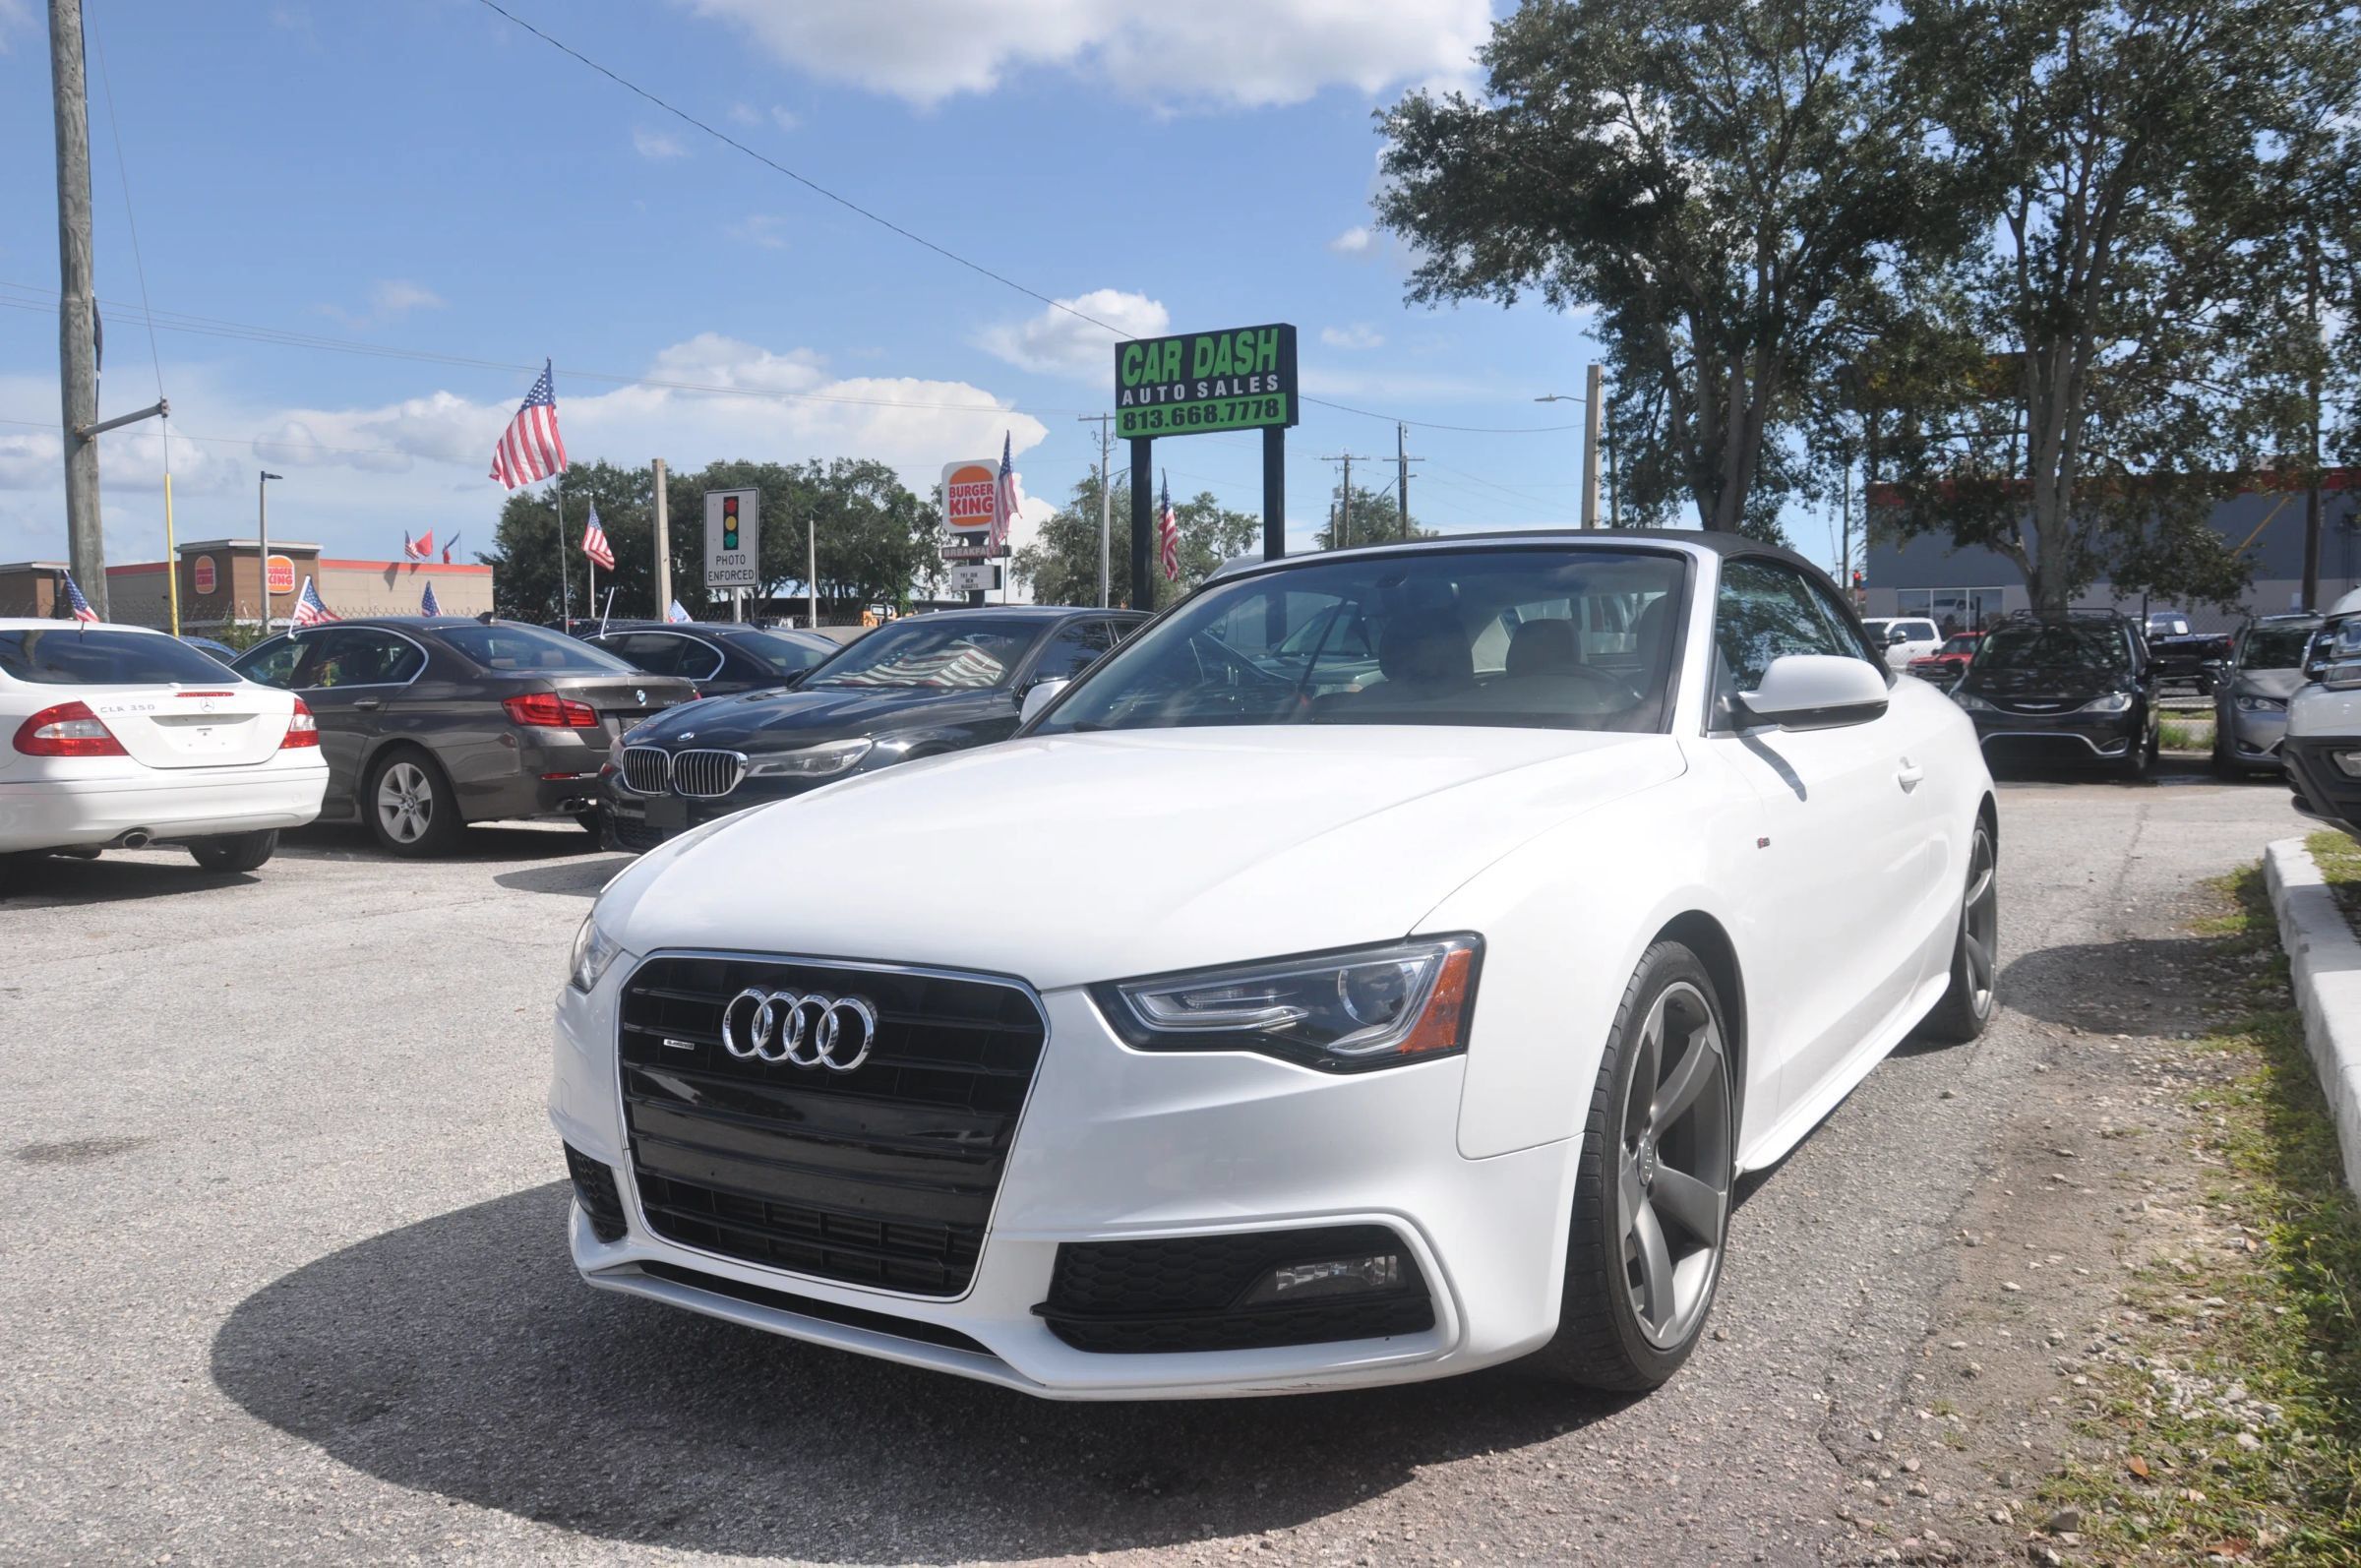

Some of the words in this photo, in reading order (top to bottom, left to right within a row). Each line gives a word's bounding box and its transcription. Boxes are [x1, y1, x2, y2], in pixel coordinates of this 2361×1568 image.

[1122, 340, 1182, 387] CAR
[1193, 329, 1278, 378] DASH
[1121, 384, 1185, 405] AUTO
[1196, 374, 1278, 398] SALES
[1122, 398, 1279, 431] 813.668.7778
[949, 483, 994, 498] BURGER
[949, 497, 994, 515] KING
[716, 554, 746, 566] PHOTO
[708, 570, 755, 581] ENFORCED
